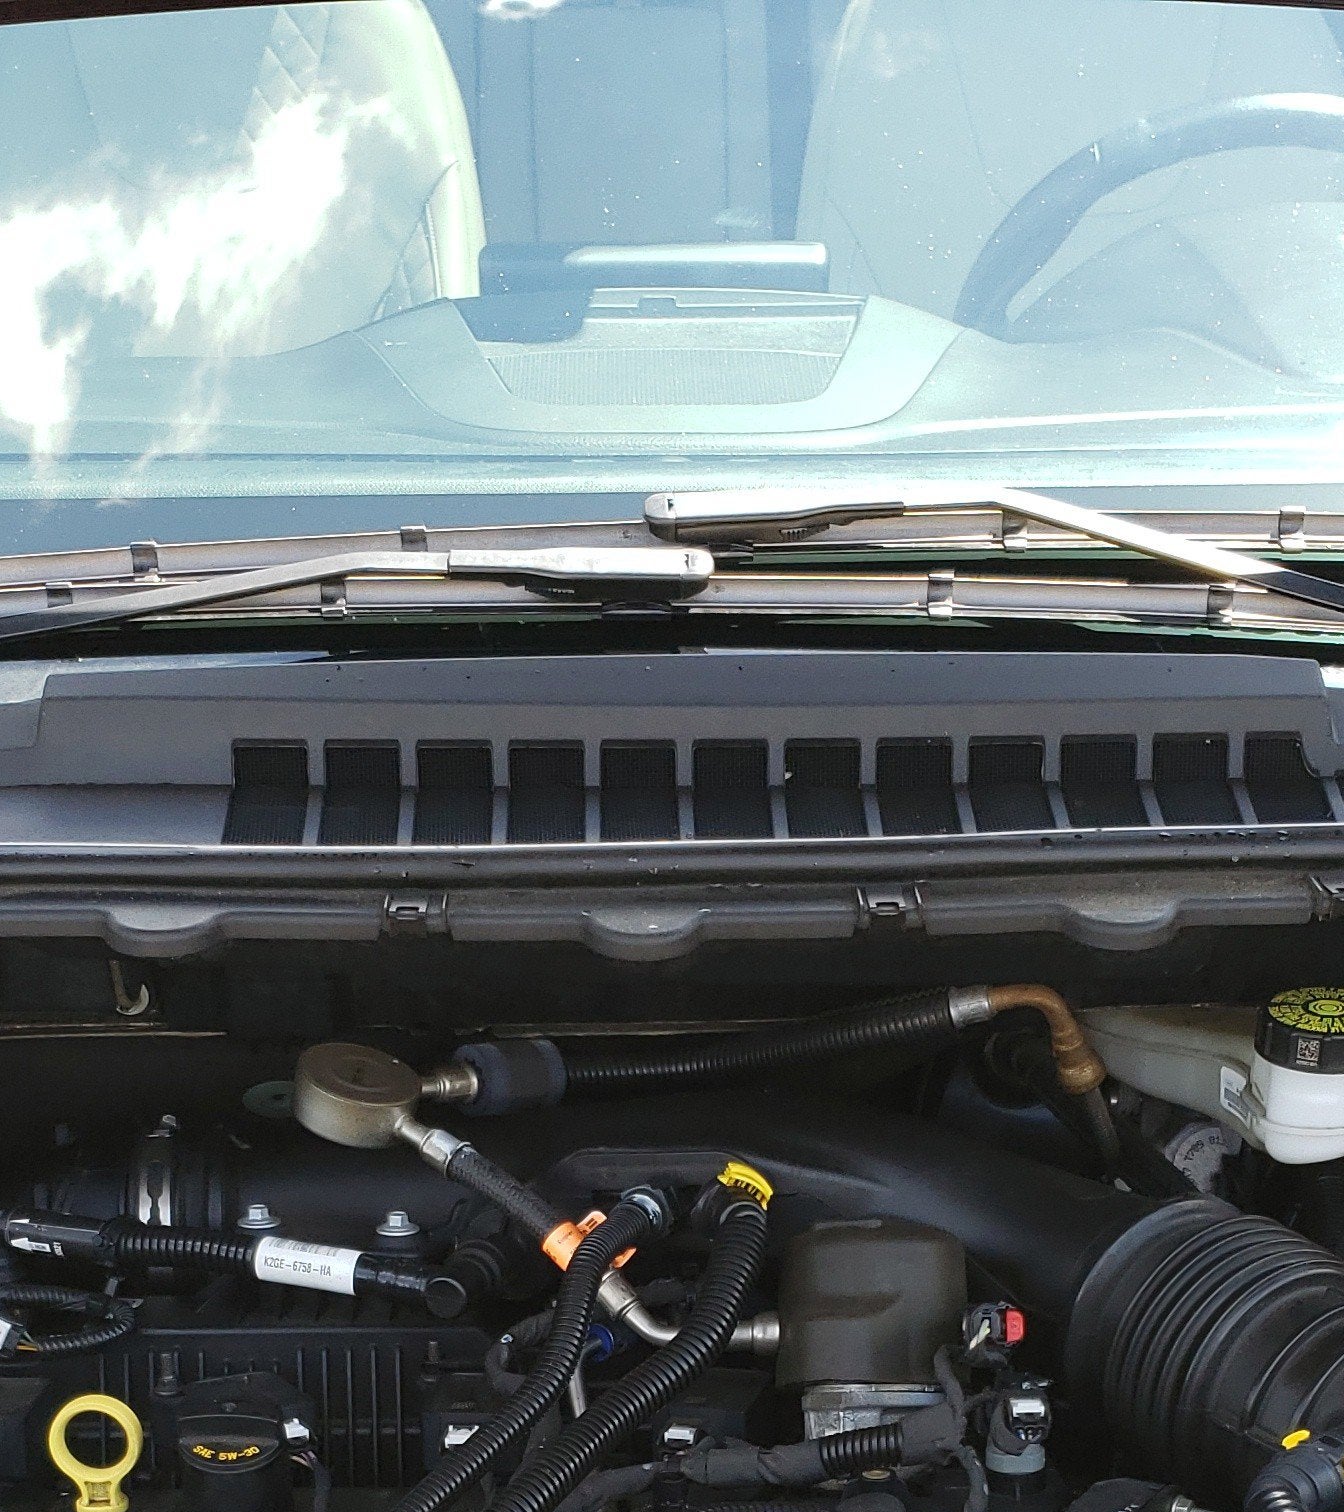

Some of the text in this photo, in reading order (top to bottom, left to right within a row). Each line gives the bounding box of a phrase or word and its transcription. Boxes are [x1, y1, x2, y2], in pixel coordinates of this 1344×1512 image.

[264, 1256, 331, 1276] K2GE-6758-HA
[192, 1445, 260, 1461] SAE 5W-30
